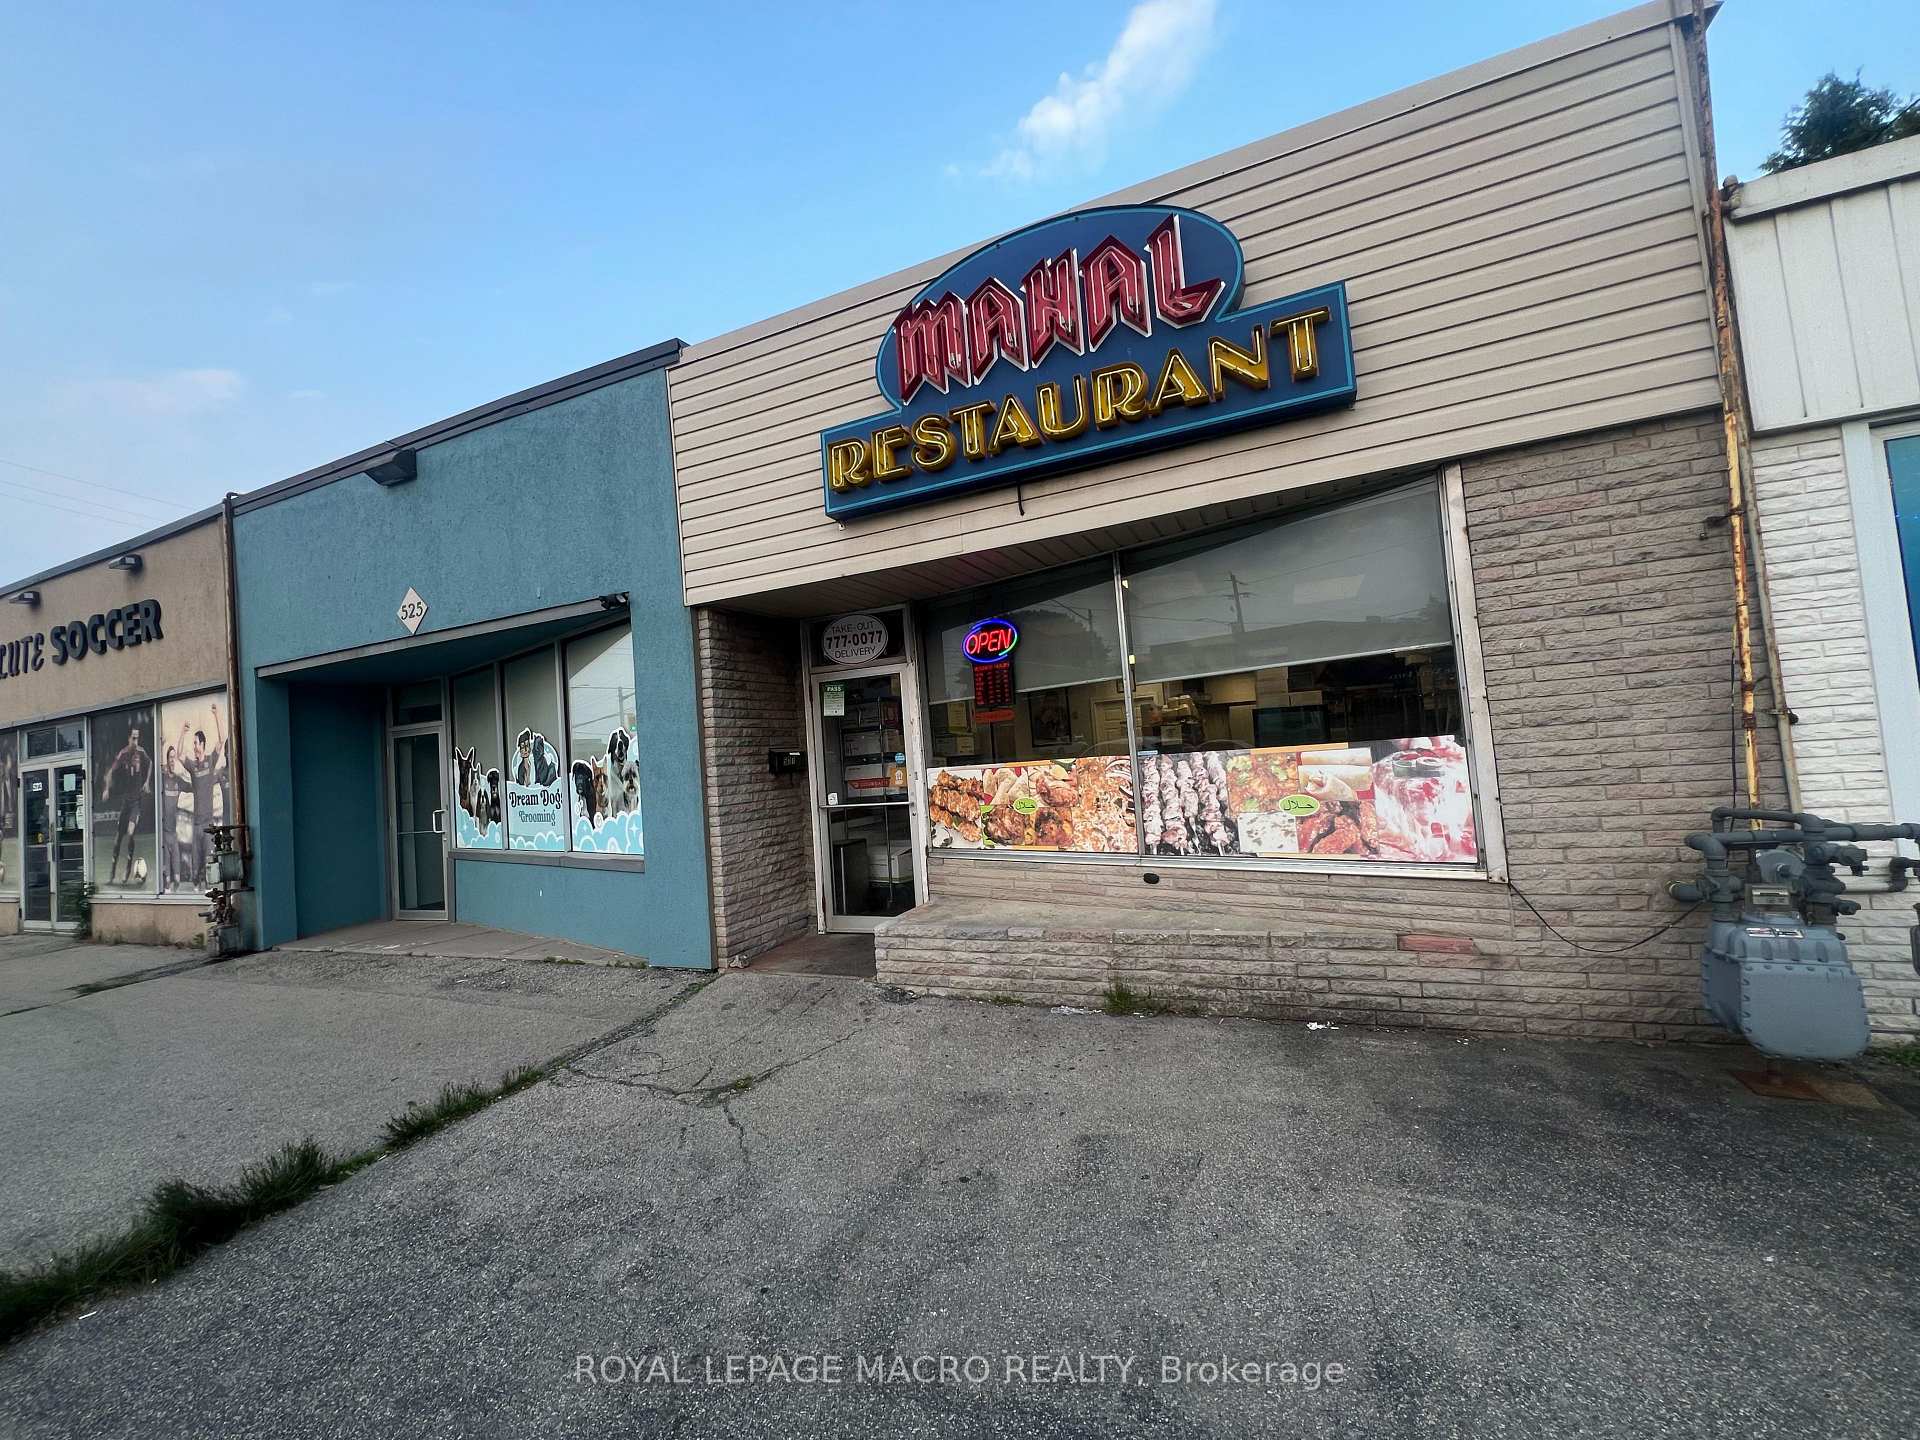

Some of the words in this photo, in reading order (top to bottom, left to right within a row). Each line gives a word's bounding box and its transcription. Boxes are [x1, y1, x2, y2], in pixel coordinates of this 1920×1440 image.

[894, 212, 1226, 406] MAHAL
[828, 306, 1331, 494] RESTAURANT
[401, 601, 424, 620] 525
[50, 599, 164, 665] SOCCER
[825, 630, 883, 649] 777-0077
[965, 627, 1012, 655] OPEN
[834, 645, 876, 659] DELIVERY
[509, 791, 539, 808] Dream
[518, 809, 556, 827] Grooming
